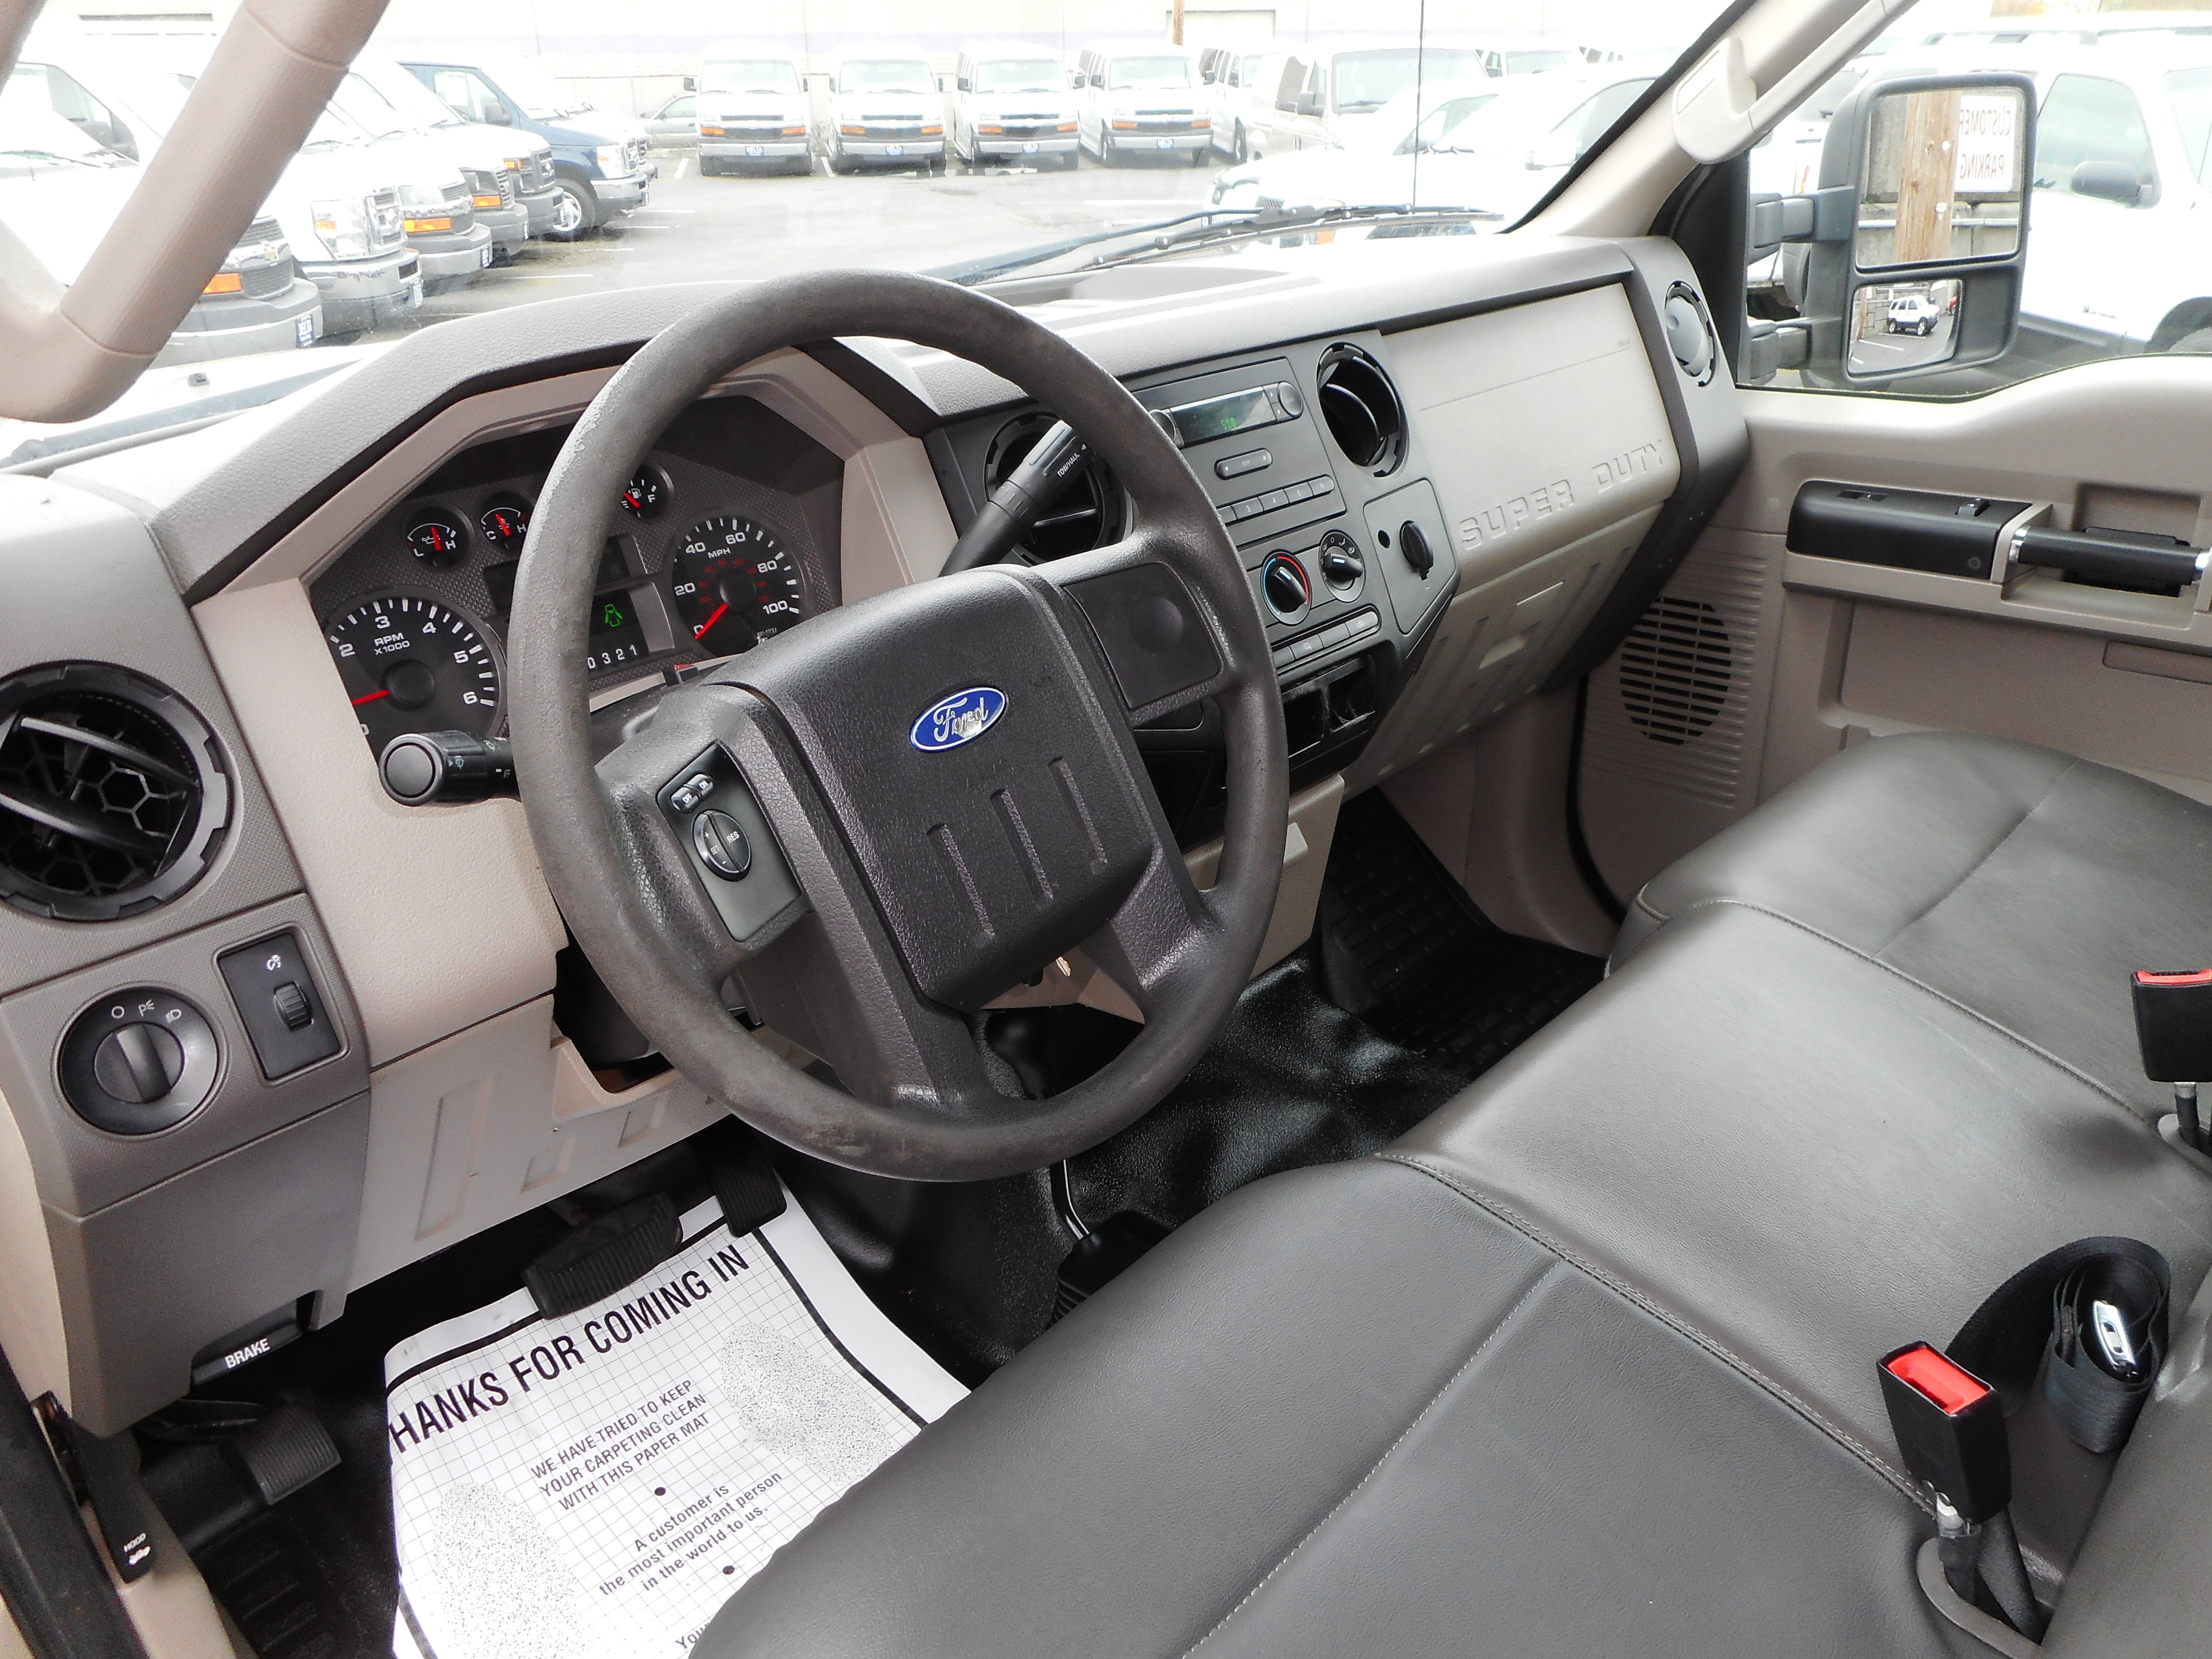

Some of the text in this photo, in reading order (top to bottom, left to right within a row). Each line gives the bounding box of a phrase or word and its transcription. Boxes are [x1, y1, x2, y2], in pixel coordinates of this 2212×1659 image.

[647, 494, 656, 503] F
[1459, 439, 1664, 551] SUPER DUTY
[517, 523, 527, 533] H
[486, 531, 496, 540] C
[725, 532, 746, 545] 60
[445, 540, 456, 550] H
[685, 541, 706, 554] 40
[413, 548, 424, 557] L
[708, 547, 731, 559] MPH
[757, 560, 778, 573] 80
[674, 582, 696, 596] 20
[762, 600, 788, 614] 100
[374, 615, 391, 629] 3
[422, 622, 437, 634] 4
[374, 632, 404, 646] RPM
[338, 643, 356, 657] 2
[374, 640, 410, 655] X1000
[453, 650, 469, 663] 5
[463, 691, 477, 705] 6
[933, 697, 989, 743] Ford
[699, 780, 709, 789] ON
[682, 793, 693, 803] OFF
[726, 831, 740, 843] RES
[710, 845, 720, 855] SET
[225, 1338, 271, 1369] BRAKE
[389, 1244, 750, 1454] HANKS FOR COMING IN
[531, 1380, 692, 1479] WE HAVE TRIED TO KEEP
[540, 1394, 707, 1497] YOUR CARPETING CLEAN
[559, 1412, 709, 1510] WITH THIS PAPER MAT
[634, 1485, 729, 1552] A customer is
[599, 1473, 782, 1595] the most important person
[123, 1532, 146, 1553] HOOD
[641, 1506, 769, 1591] in the world to us.
[675, 1623, 710, 1649] You
